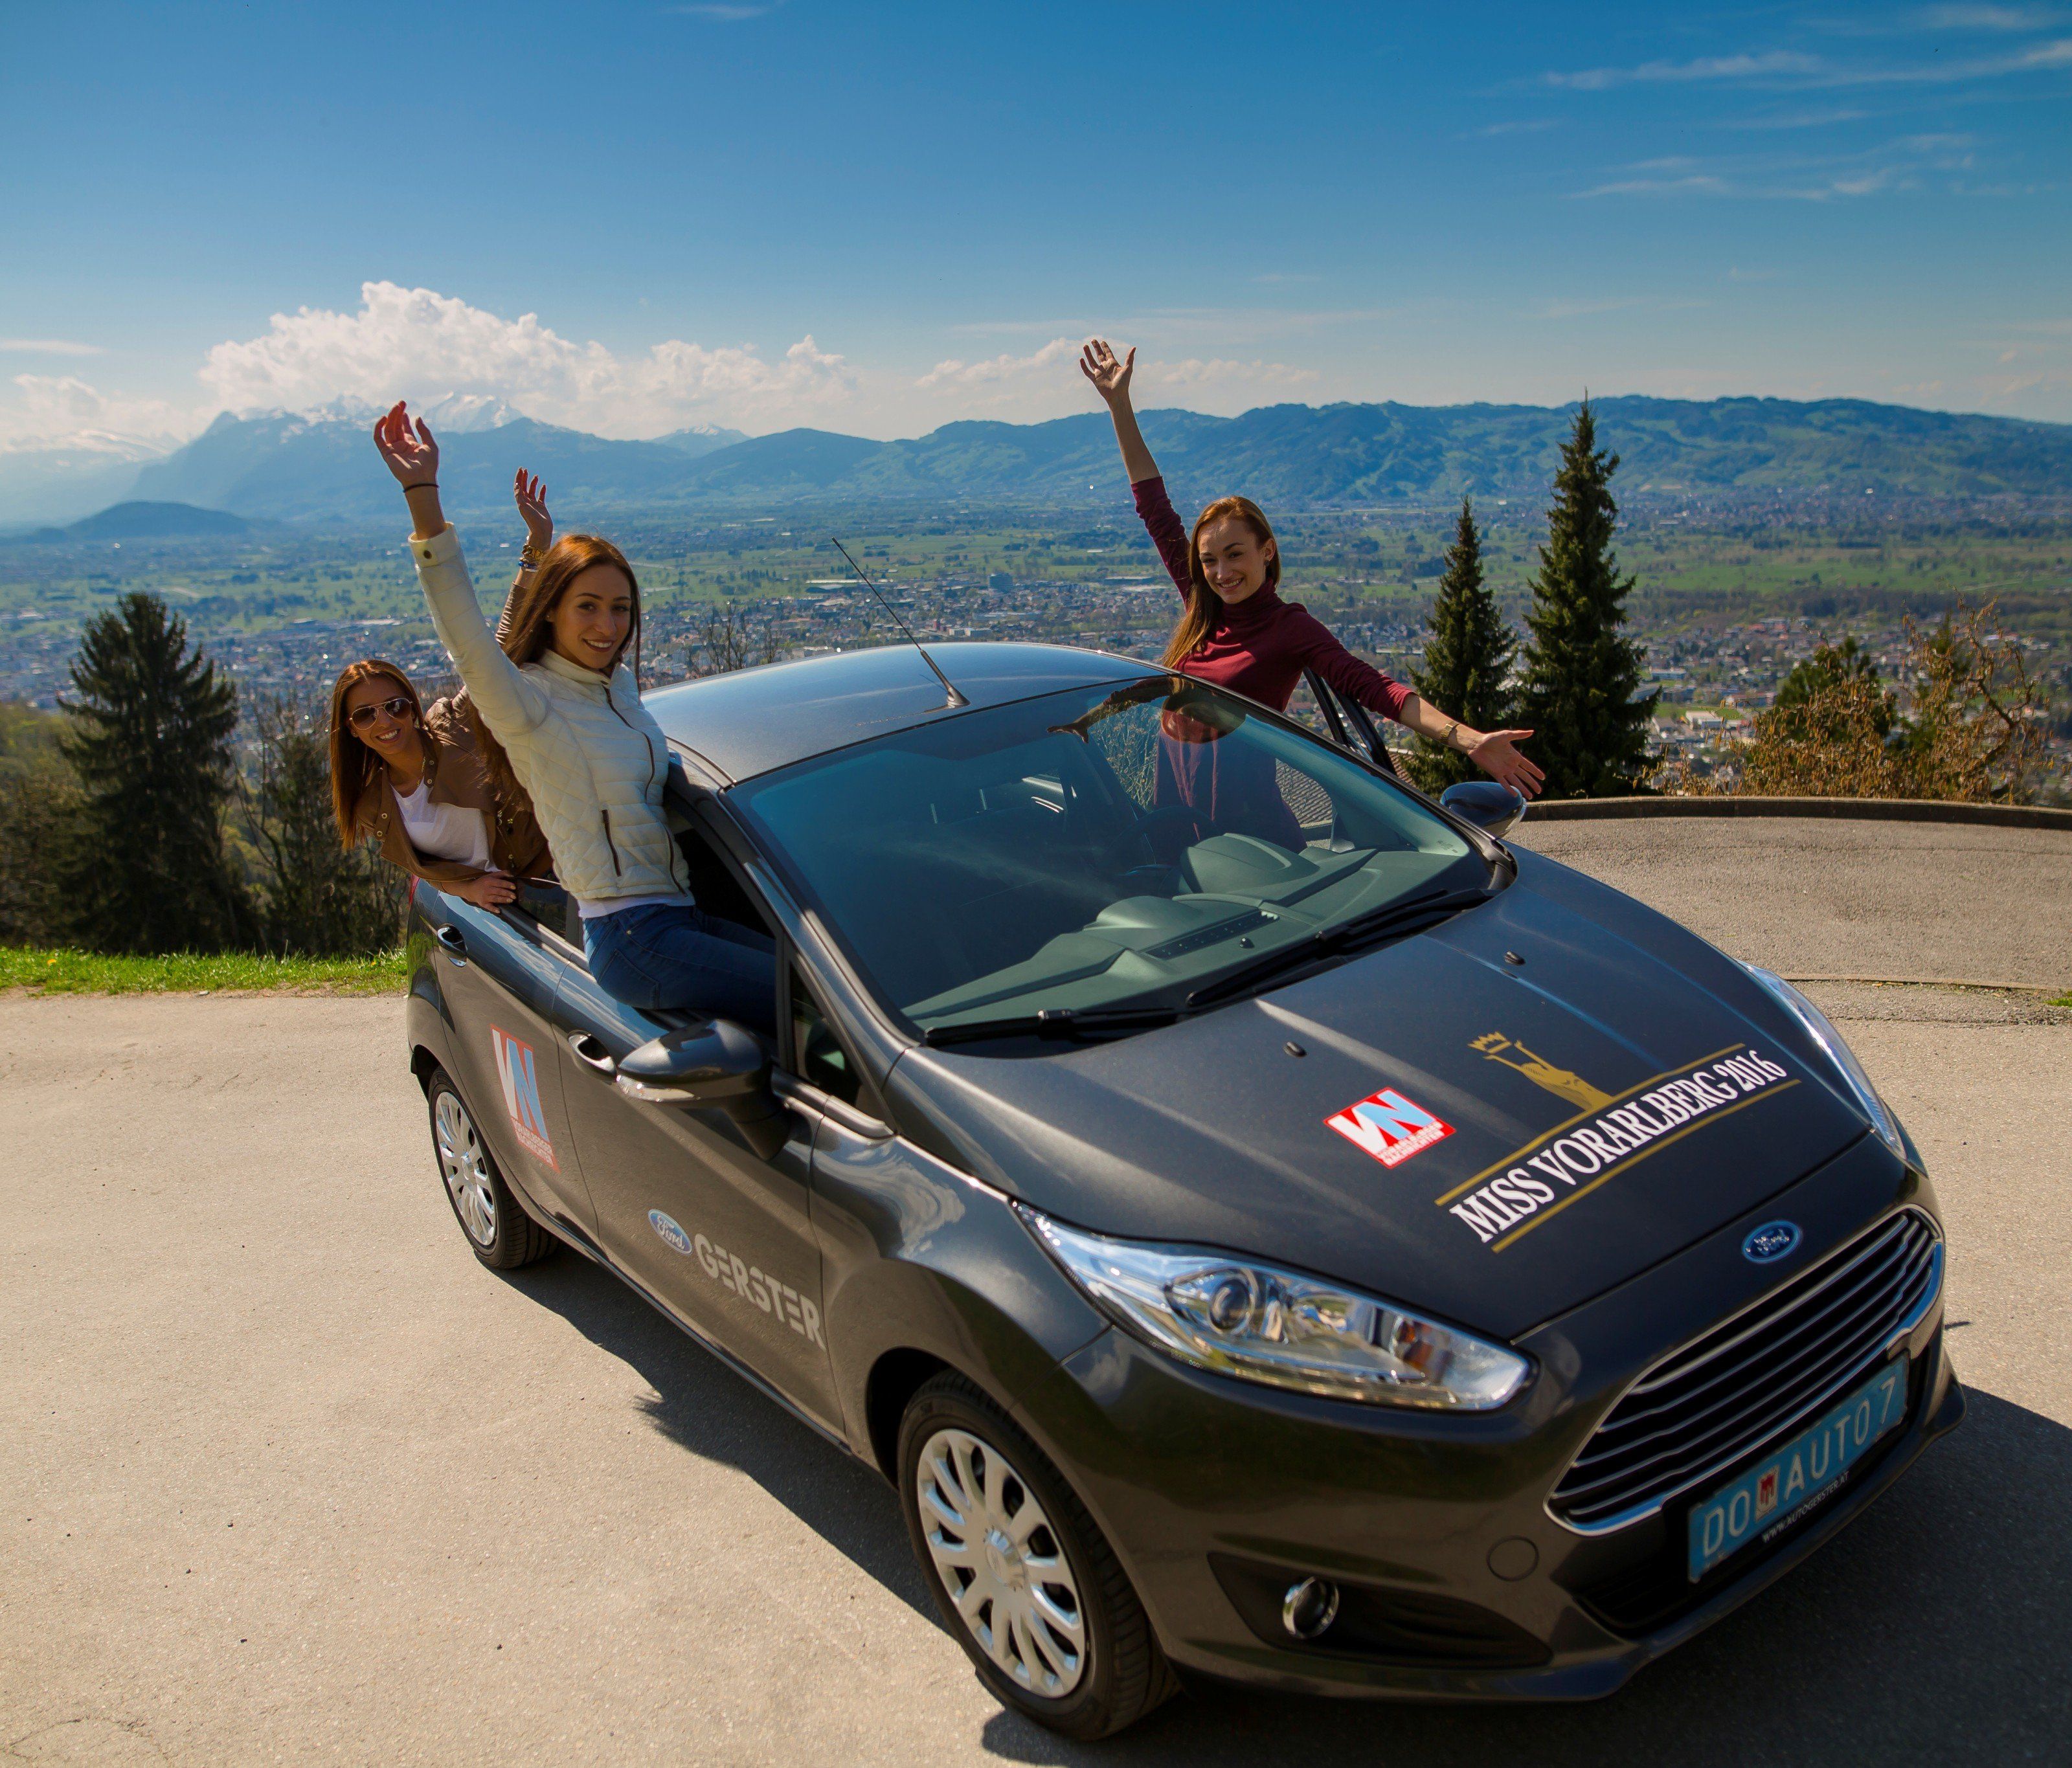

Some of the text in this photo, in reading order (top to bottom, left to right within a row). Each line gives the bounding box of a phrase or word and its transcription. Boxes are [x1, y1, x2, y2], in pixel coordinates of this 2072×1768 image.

[492, 1029, 550, 1143] VN
[1327, 1090, 1436, 1154] VN
[1448, 1167, 1555, 1243] MISS
[1527, 1071, 1739, 1186] VORARLBERG
[1722, 1049, 1788, 1092] 2016
[695, 1233, 827, 1352] GERSTER
[1704, 1490, 1751, 1558] DO
[1761, 1470, 1850, 1543] WWW.AUTOGERSTER.AT
